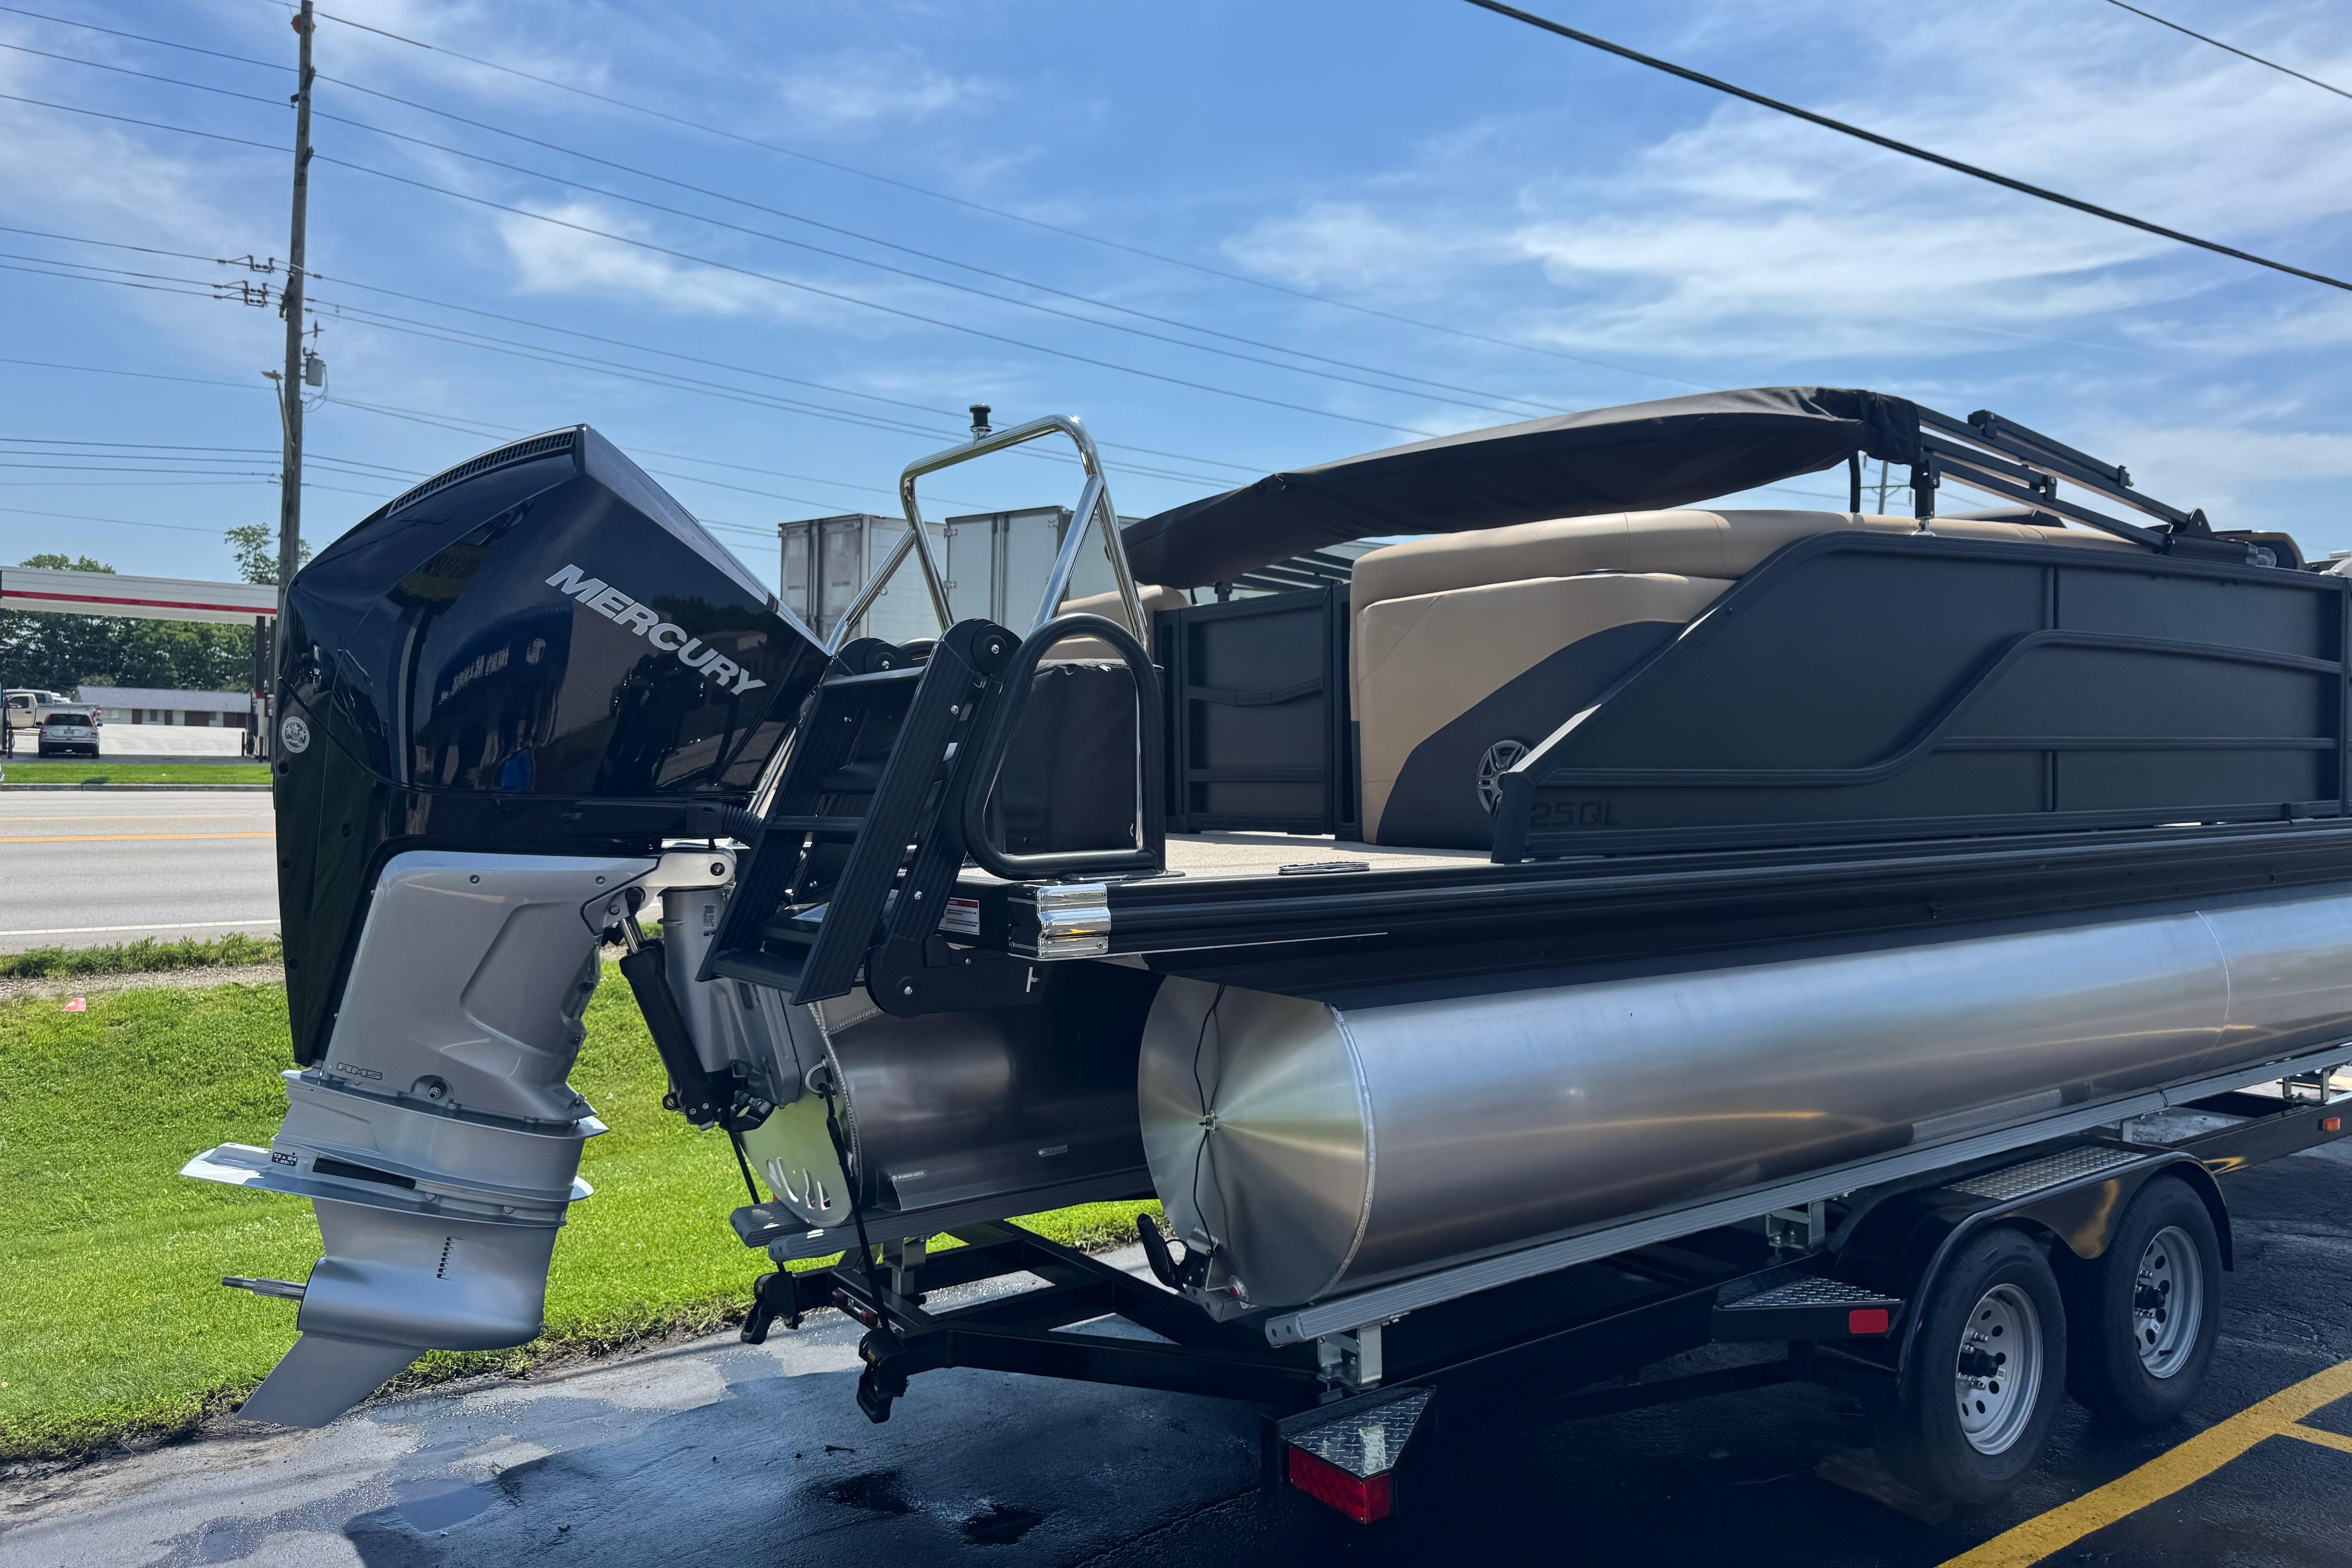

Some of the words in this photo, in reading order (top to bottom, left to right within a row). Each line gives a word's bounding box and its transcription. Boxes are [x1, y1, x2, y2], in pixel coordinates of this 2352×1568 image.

[545, 564, 767, 695] MERCURY
[1530, 801, 1622, 828] 25QL
[336, 1062, 383, 1080] AMS
